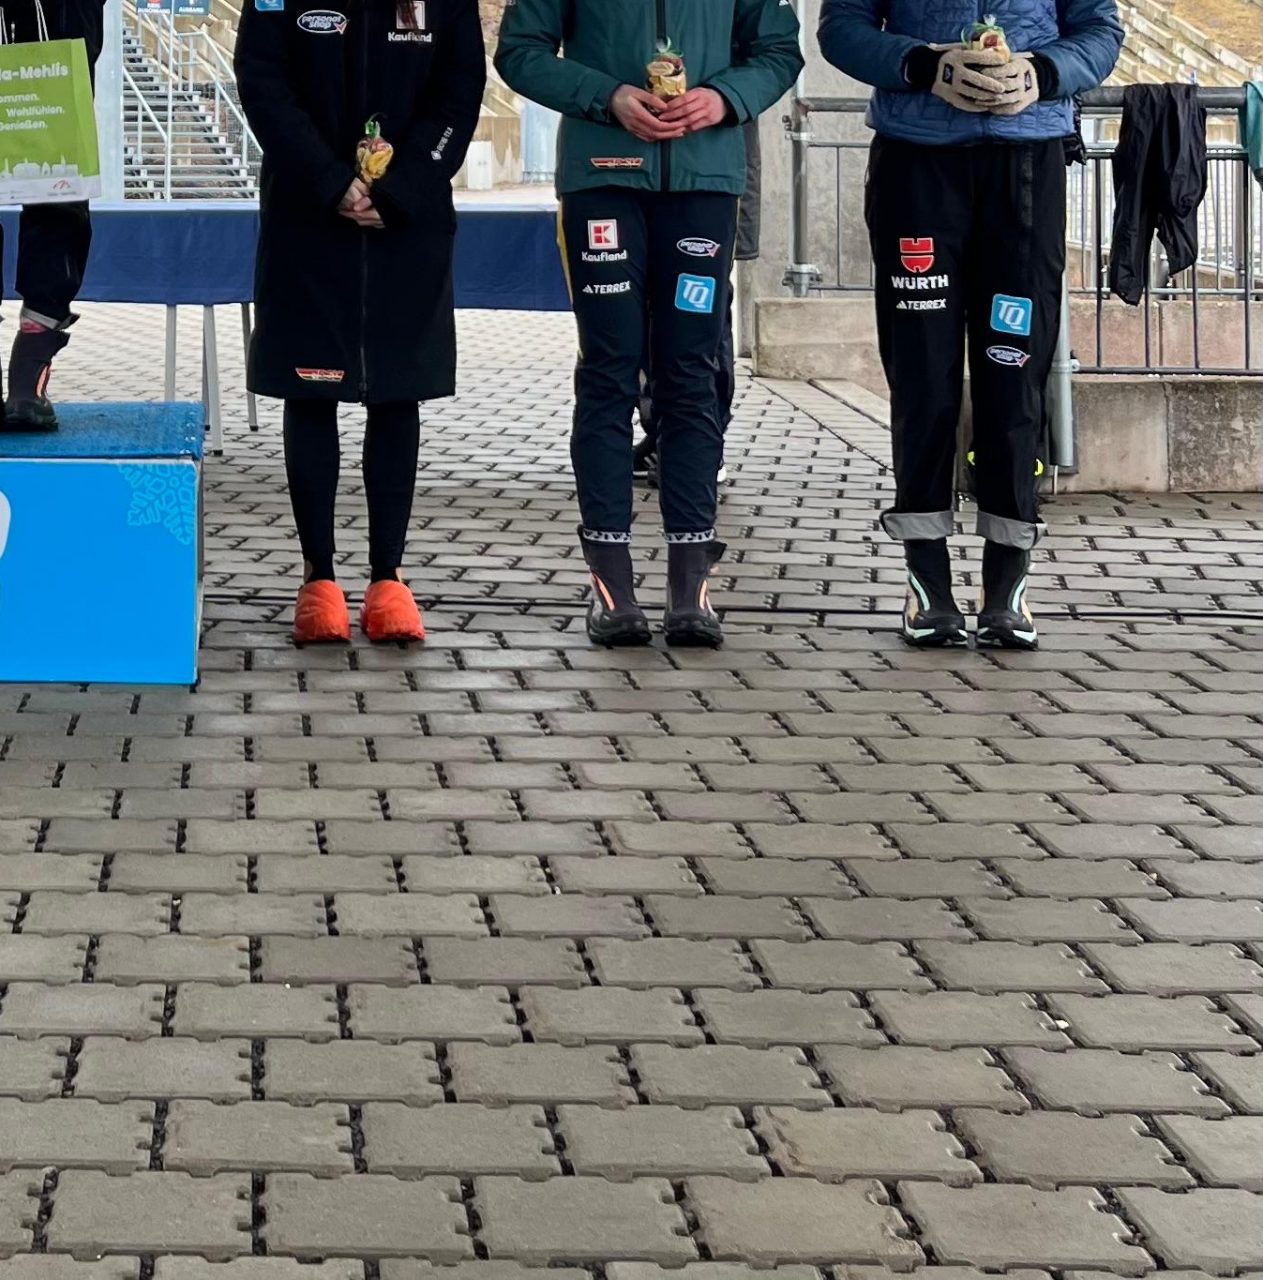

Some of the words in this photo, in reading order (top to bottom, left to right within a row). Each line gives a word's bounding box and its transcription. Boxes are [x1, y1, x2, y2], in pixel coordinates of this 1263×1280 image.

[581, 249, 628, 262] Kaufland
[593, 280, 631, 295] TERREX
[682, 279, 709, 309] TQ
[907, 298, 948, 311] TERREX
[998, 300, 1026, 330] TQ
